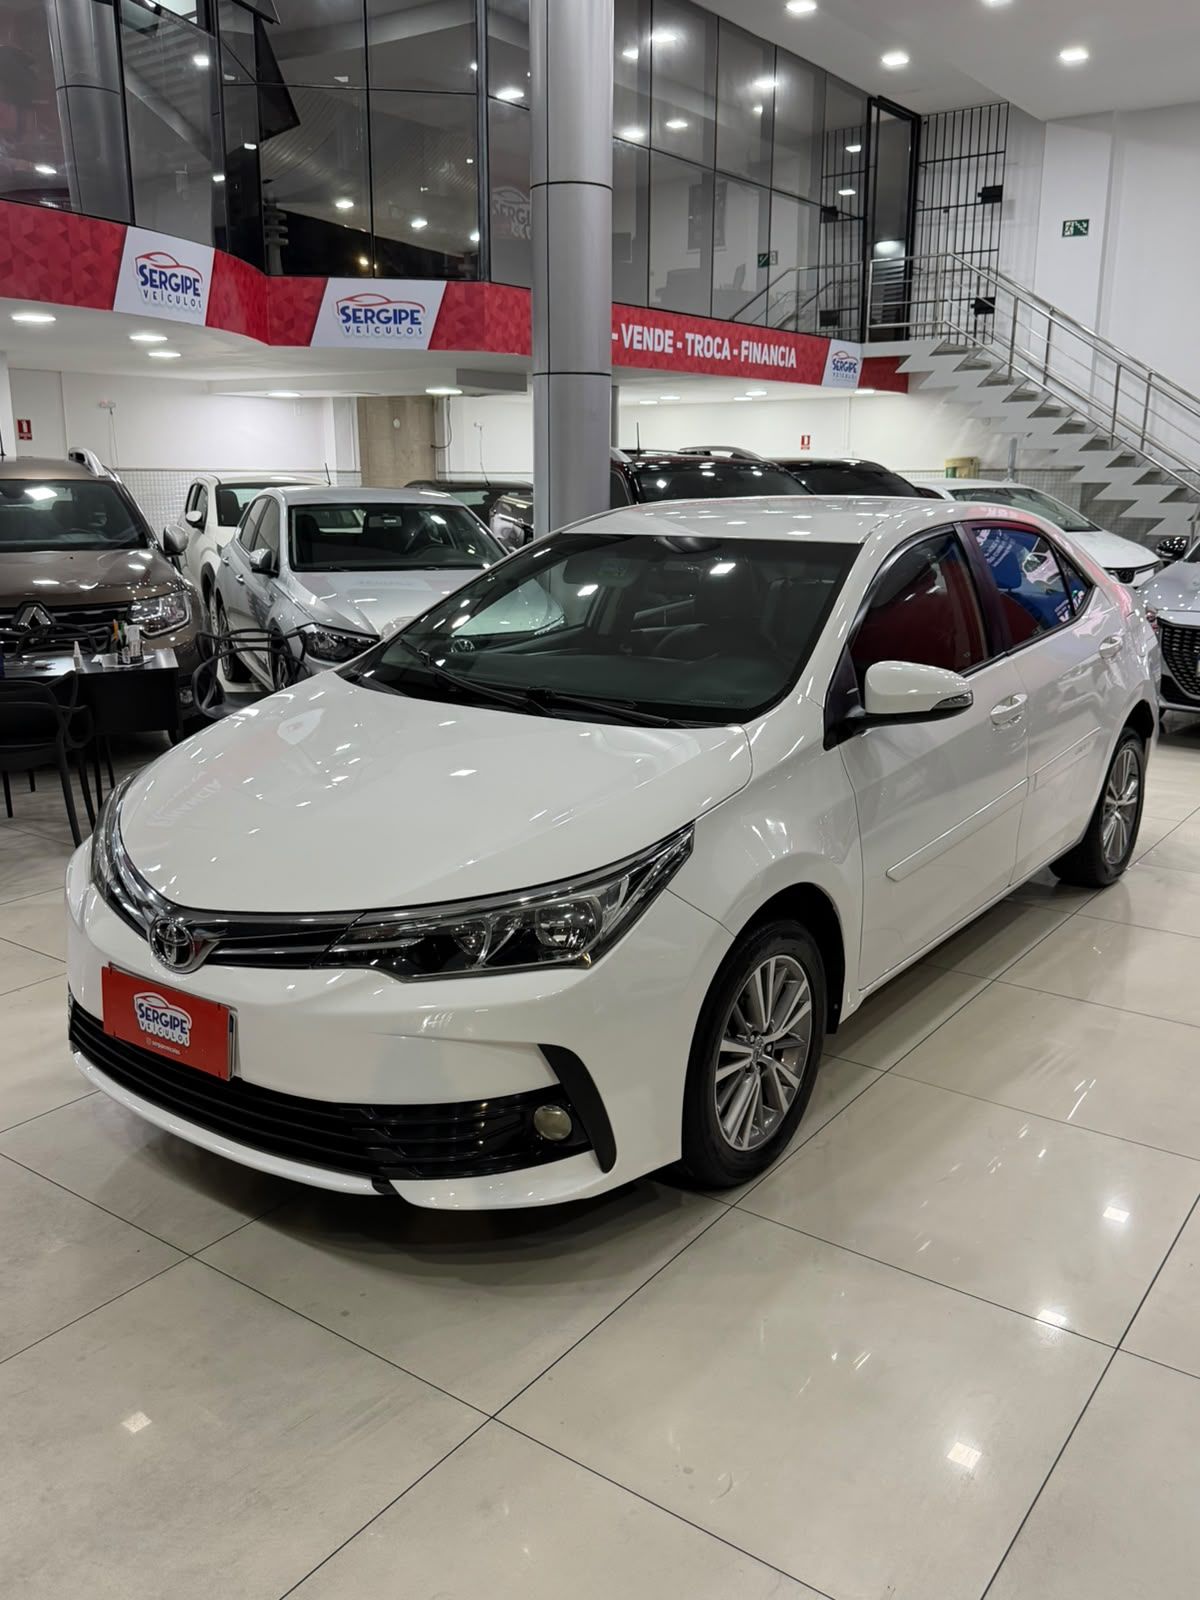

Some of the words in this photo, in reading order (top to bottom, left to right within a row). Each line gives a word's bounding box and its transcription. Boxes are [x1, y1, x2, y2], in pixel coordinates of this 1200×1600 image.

[138, 264, 201, 297] SERGIPE
[340, 305, 422, 325] SERGIPE
[620, 323, 674, 353] VENDE
[684, 332, 731, 361] TROCA
[740, 340, 797, 368] FINANCIA
[832, 358, 857, 374] SERGIPE
[138, 1003, 188, 1035] SERGIPE
